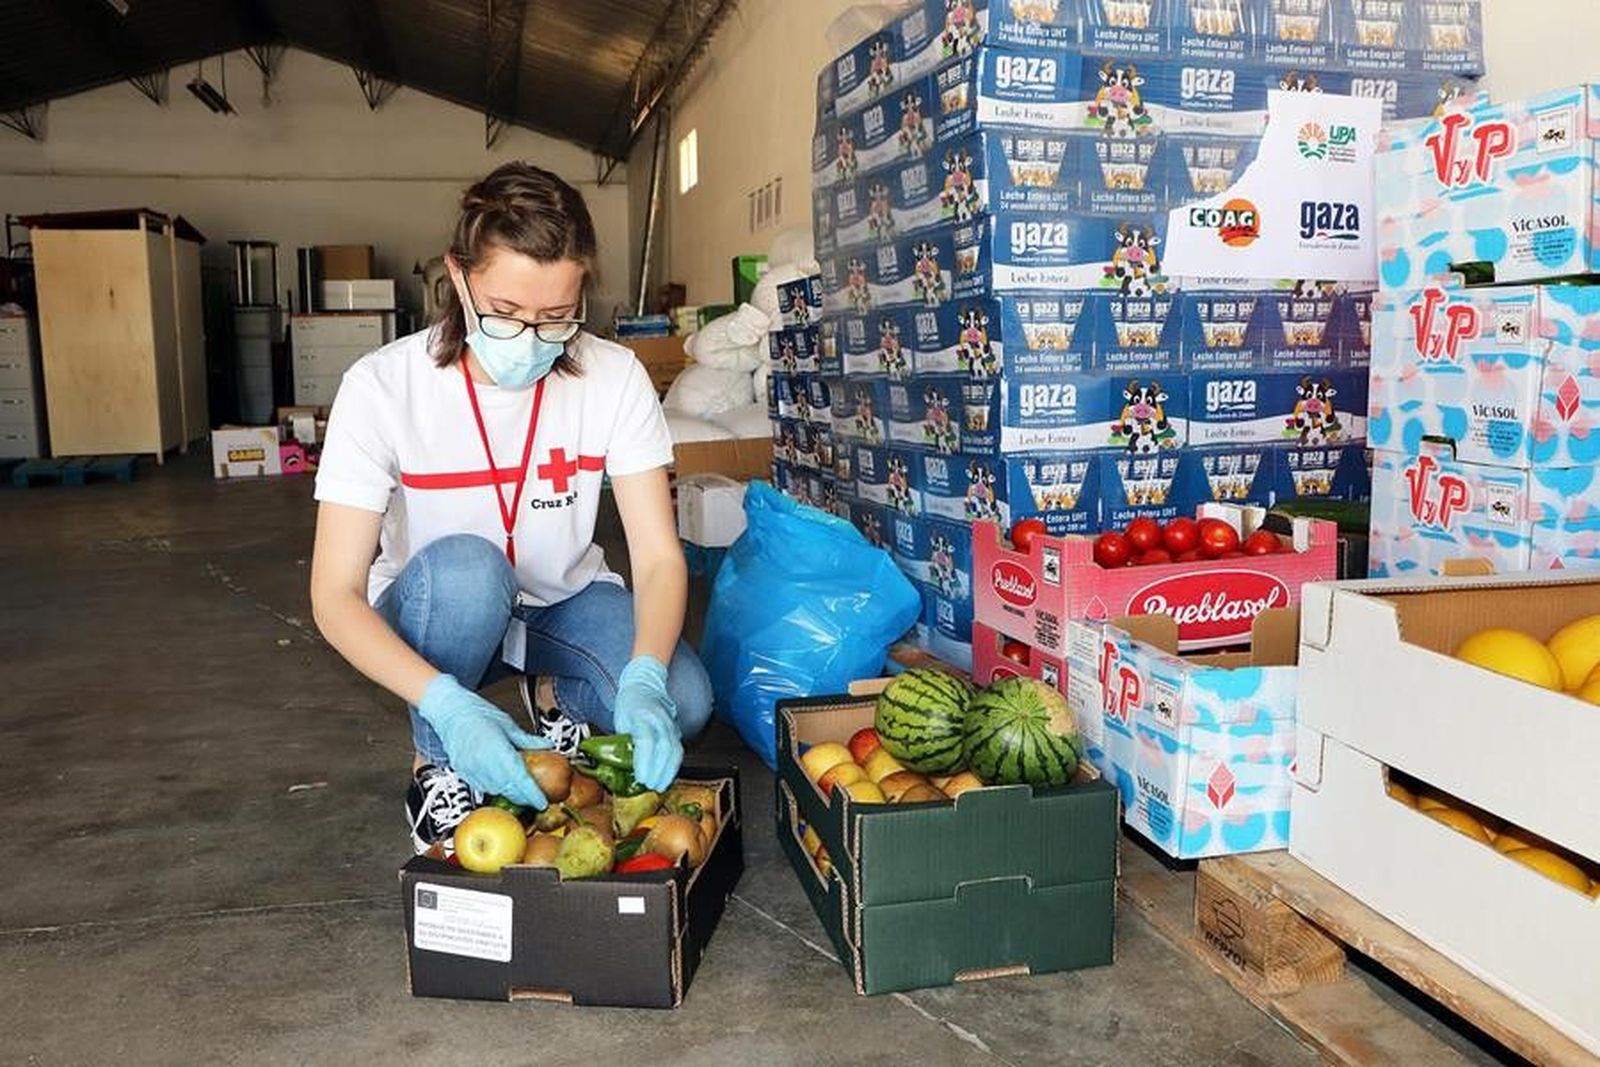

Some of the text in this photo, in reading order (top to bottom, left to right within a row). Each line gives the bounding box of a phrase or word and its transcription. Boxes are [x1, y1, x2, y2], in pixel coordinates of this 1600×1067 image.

[996, 56, 1057, 89] gaza
[1181, 67, 1235, 100] gaza
[1328, 125, 1357, 145] UPA
[1190, 208, 1255, 228] COAG
[1300, 201, 1360, 239] gaza
[1011, 222, 1069, 255] gaza
[1033, 302, 1059, 318] gaza
[1127, 302, 1152, 317] gaza
[1020, 384, 1077, 416] gaza
[1207, 380, 1256, 412] gaza
[1020, 433, 1077, 445] Leche Entera
[1204, 426, 1256, 438] Leche Entera
[531, 498, 562, 510] Cruz
[1112, 510, 1135, 520] Leche
[1162, 506, 1176, 518] UHT
[1046, 511, 1087, 524] Entera UHT
[994, 568, 1036, 600] Pueblasol
[1144, 586, 1281, 625] Pueblasol
